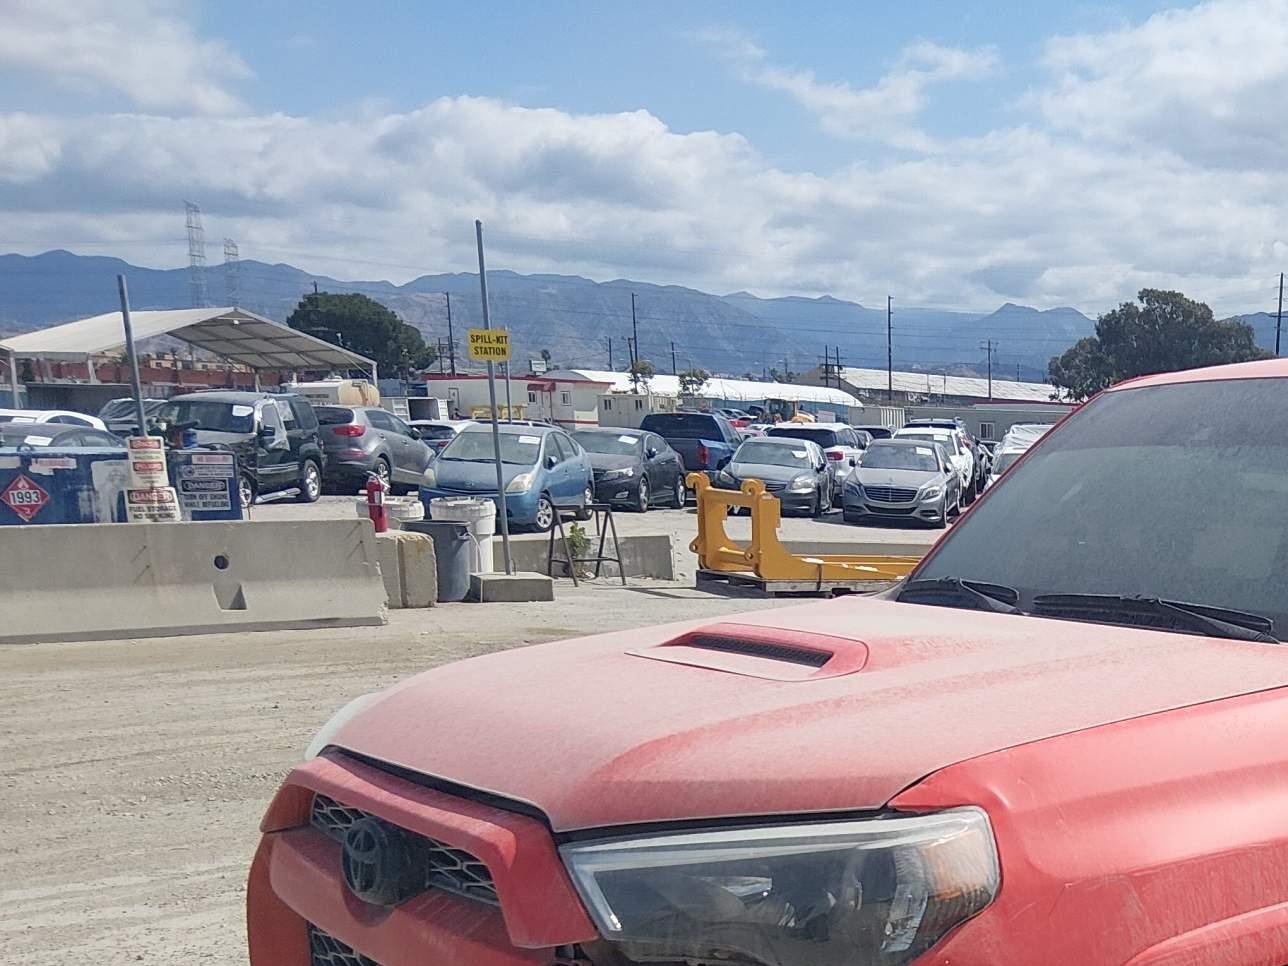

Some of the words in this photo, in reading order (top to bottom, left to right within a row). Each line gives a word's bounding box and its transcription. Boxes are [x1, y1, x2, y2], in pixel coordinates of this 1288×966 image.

[470, 334, 508, 345] SPILL-KIT
[473, 346, 507, 356] STATION
[10, 491, 41, 504] 1993
